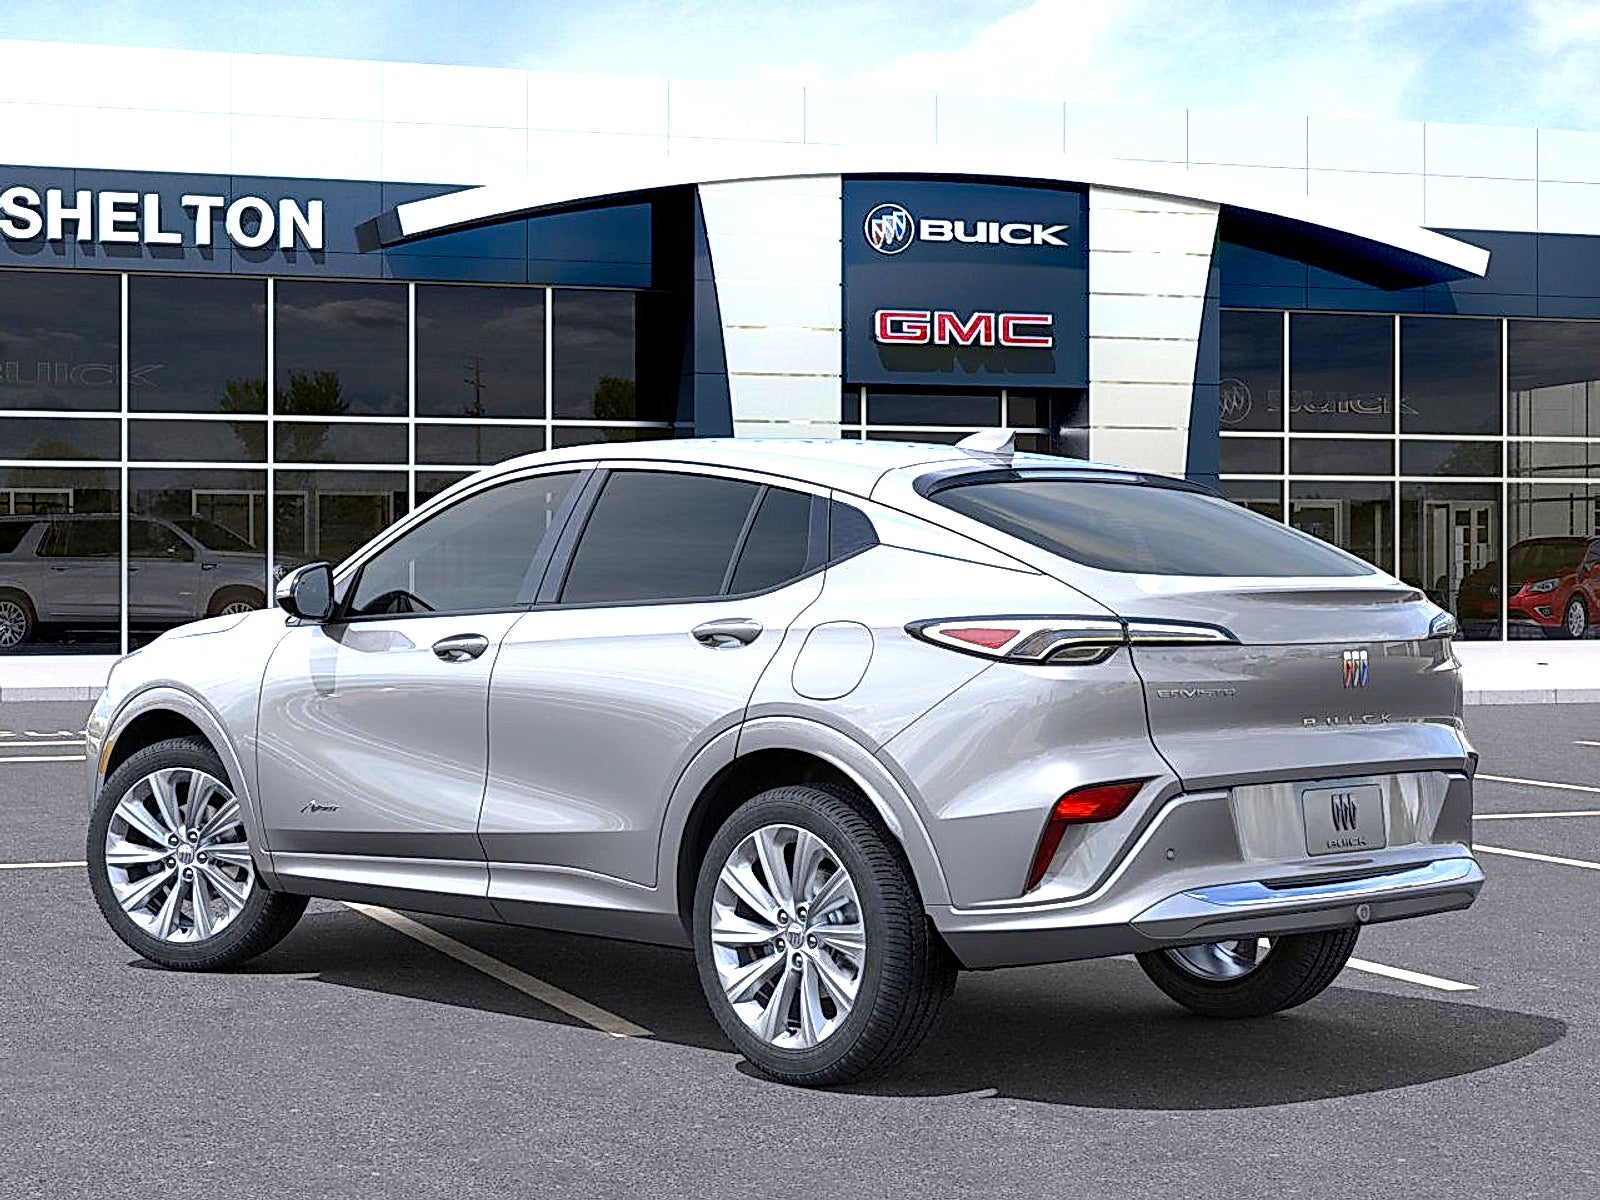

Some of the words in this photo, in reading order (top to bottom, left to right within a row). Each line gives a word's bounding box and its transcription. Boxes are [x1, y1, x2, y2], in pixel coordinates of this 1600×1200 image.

[0, 186, 323, 250] SHELTON
[920, 218, 1070, 247] BUICK
[874, 309, 1053, 348] GMC
[1302, 713, 1392, 727] BUICK
